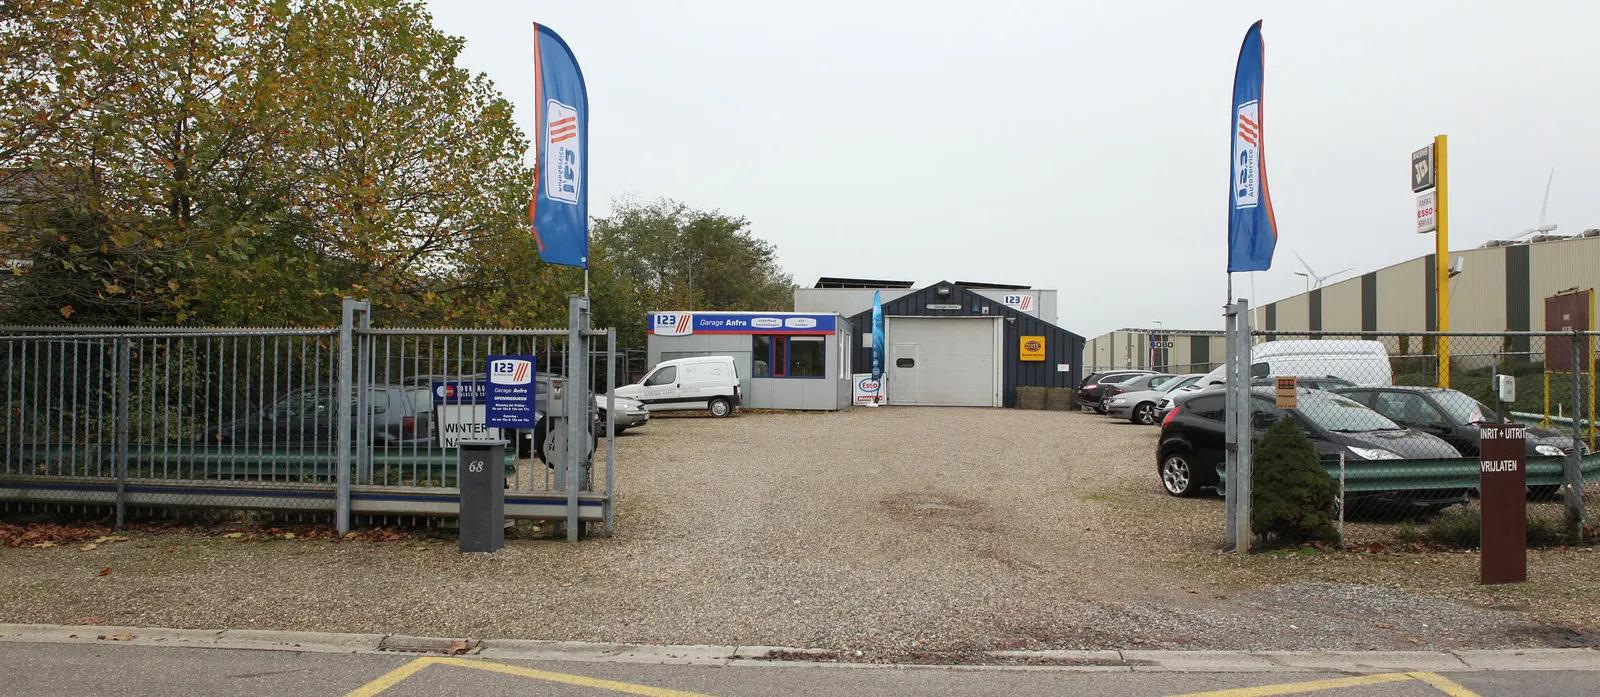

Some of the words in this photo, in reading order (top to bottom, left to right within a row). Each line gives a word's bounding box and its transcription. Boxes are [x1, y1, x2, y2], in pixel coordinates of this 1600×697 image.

[1239, 149, 1248, 197] 123
[1418, 207, 1432, 218] ESSO
[657, 315, 676, 324] 123
[494, 362, 514, 373] 123
[445, 423, 487, 433] WINTER
[1480, 428, 1498, 439] INRIT
[1500, 430, 1504, 438] +
[1505, 427, 1526, 439] UITRIT
[469, 461, 484, 473] 68
[1480, 460, 1517, 472] VRIJLATEN
